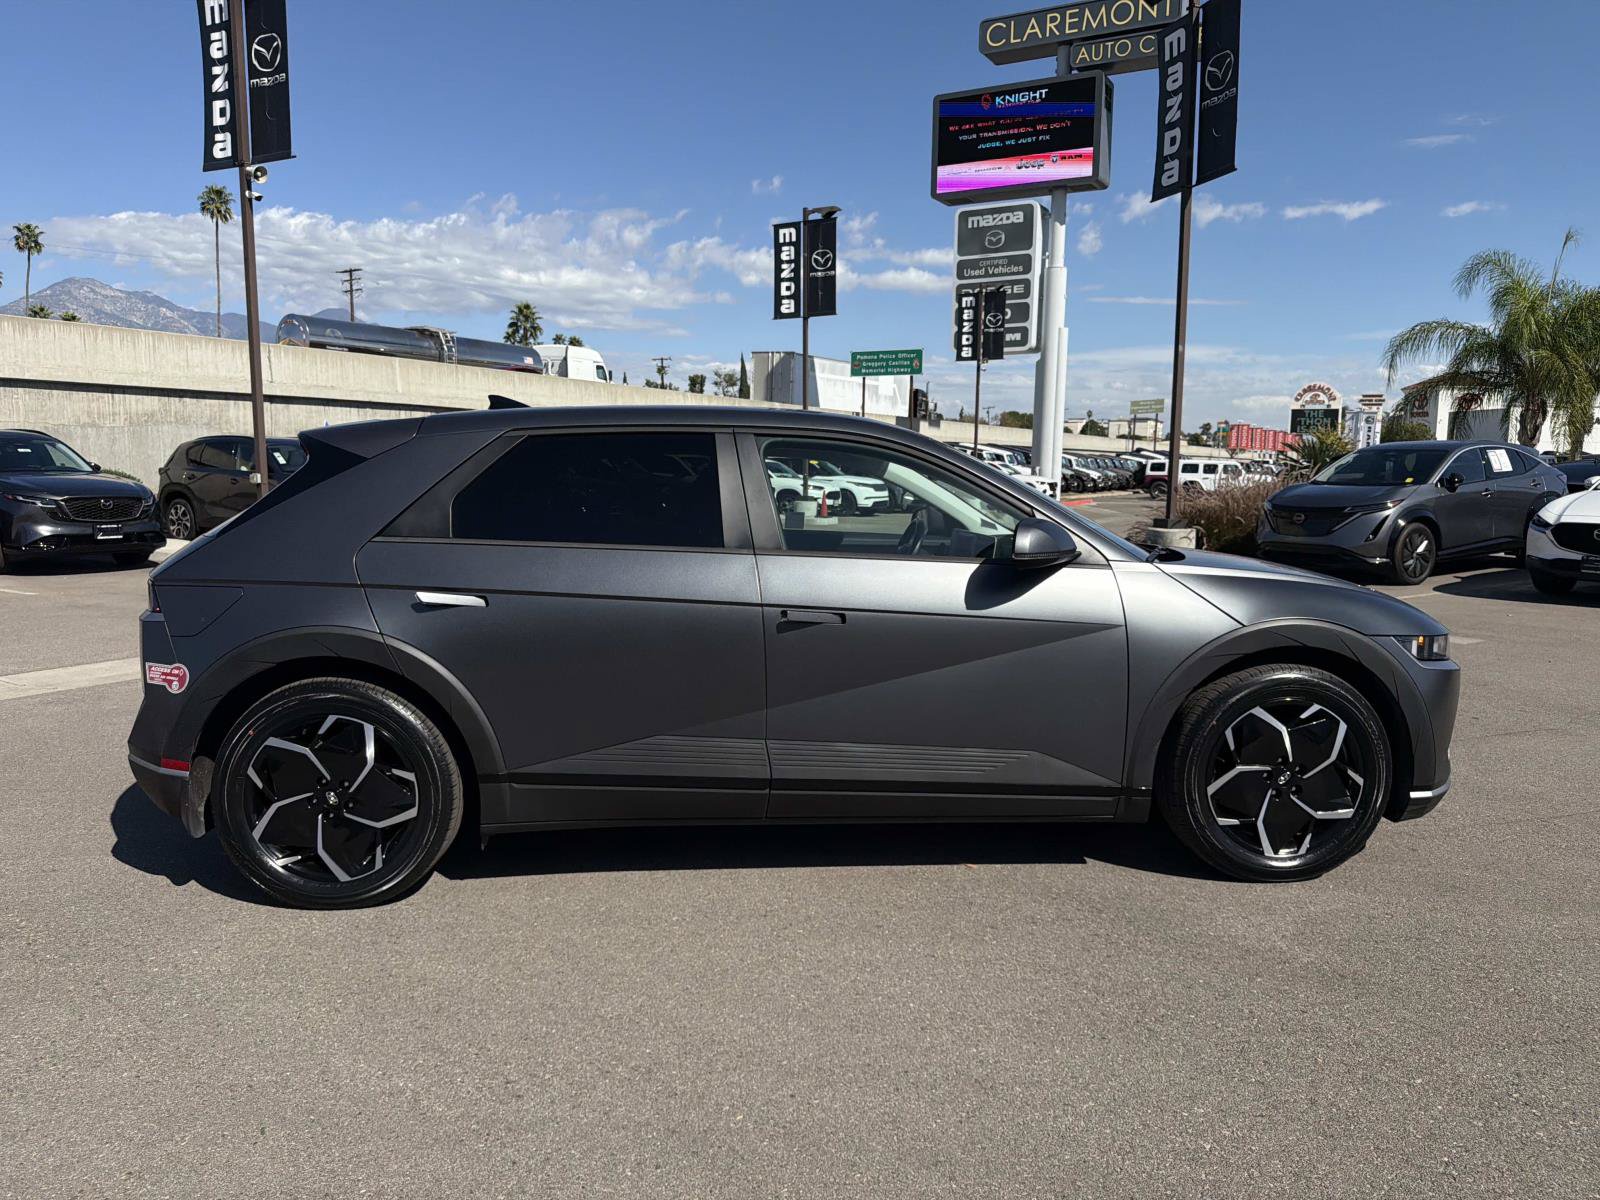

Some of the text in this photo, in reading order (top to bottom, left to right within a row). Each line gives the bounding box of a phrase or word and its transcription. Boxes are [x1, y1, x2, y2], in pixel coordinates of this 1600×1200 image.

[1075, 40, 1131, 64] AUTO
[204, 0, 232, 159] mazda
[250, 73, 286, 88] mazda
[995, 89, 1048, 104] KNIGHT
[1161, 27, 1186, 188] mazda
[1202, 87, 1236, 110] mazda
[968, 211, 1024, 228] mazda
[779, 227, 796, 314] mazda
[964, 265, 1023, 277] Used Vehicles
[979, 258, 1008, 267] CERTIFIED
[961, 296, 976, 358] mazda
